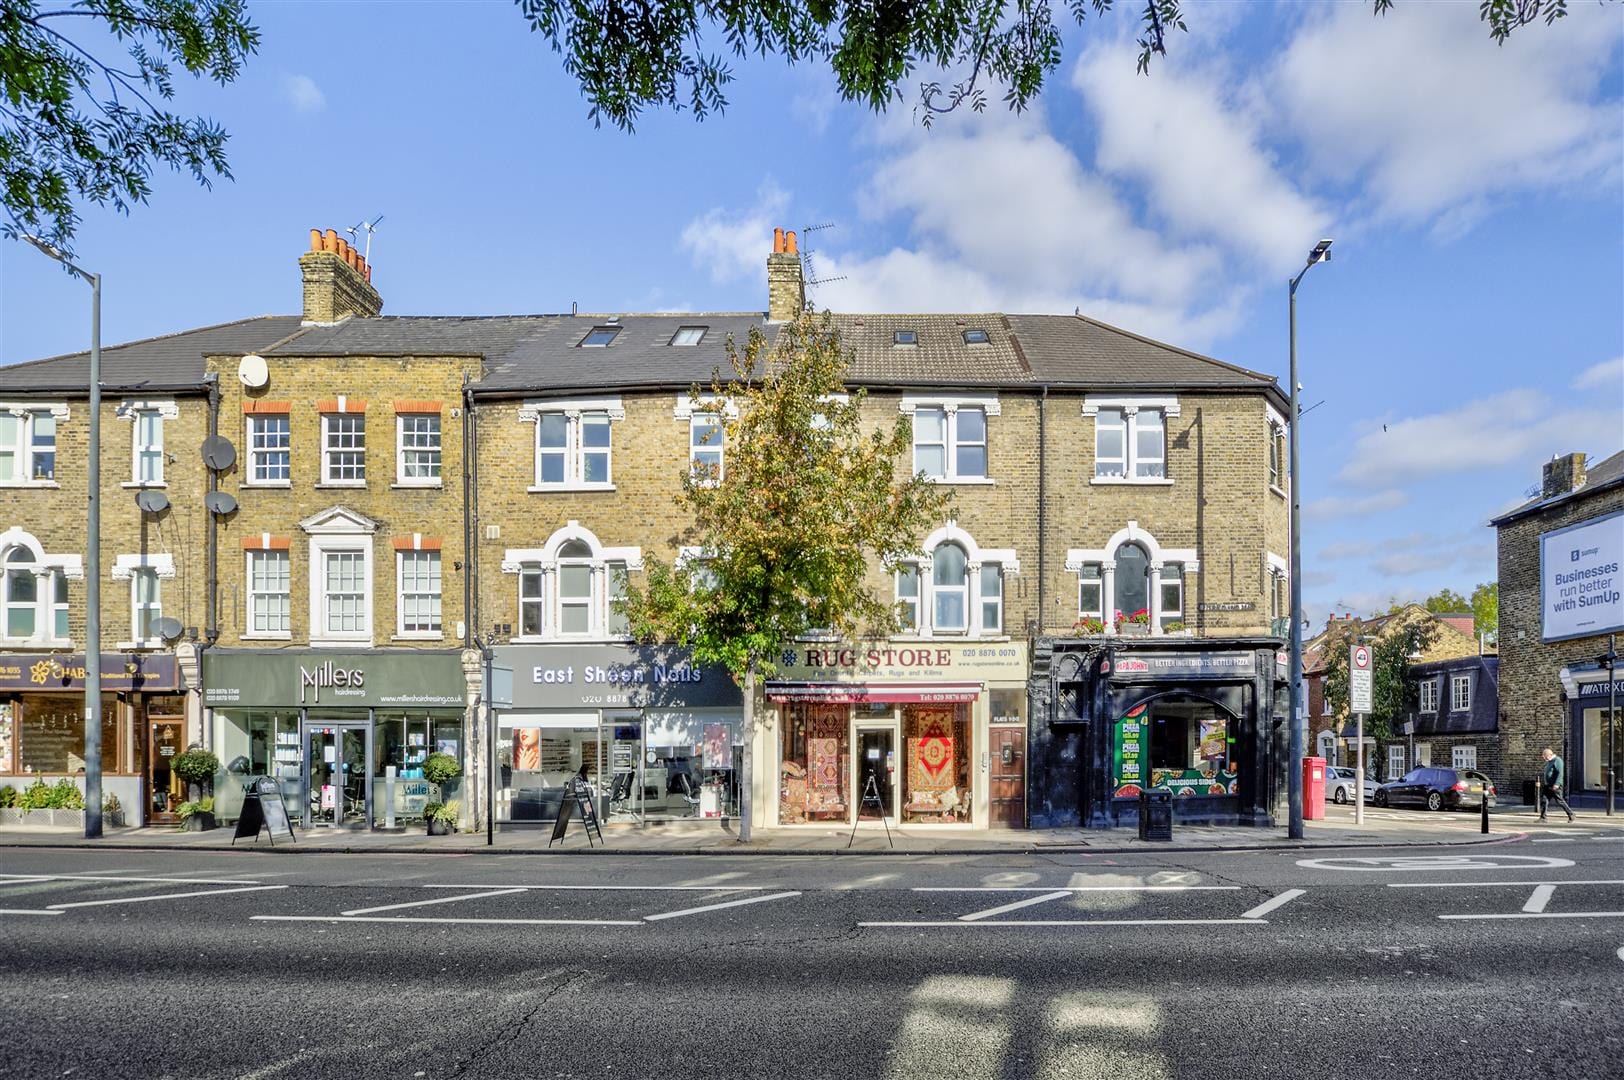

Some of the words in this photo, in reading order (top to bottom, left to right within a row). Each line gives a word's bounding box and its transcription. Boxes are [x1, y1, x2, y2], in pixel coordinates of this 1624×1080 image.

[1555, 562, 1618, 586] Businesses
[1560, 586, 1576, 598] run
[1579, 578, 1612, 594] better
[1554, 599, 1576, 612] with
[1578, 590, 1620, 608] SumUp
[805, 649, 857, 667] RUG
[867, 649, 951, 667] STORE
[1116, 662, 1129, 670] PAPA
[1155, 659, 1175, 667] BETTER
[52, 667, 85, 678] CHAB
[533, 666, 574, 683] East
[584, 666, 644, 683] Sheen
[654, 666, 701, 682] Nails
[300, 660, 364, 703] Millers
[334, 688, 366, 696] hairdressing
